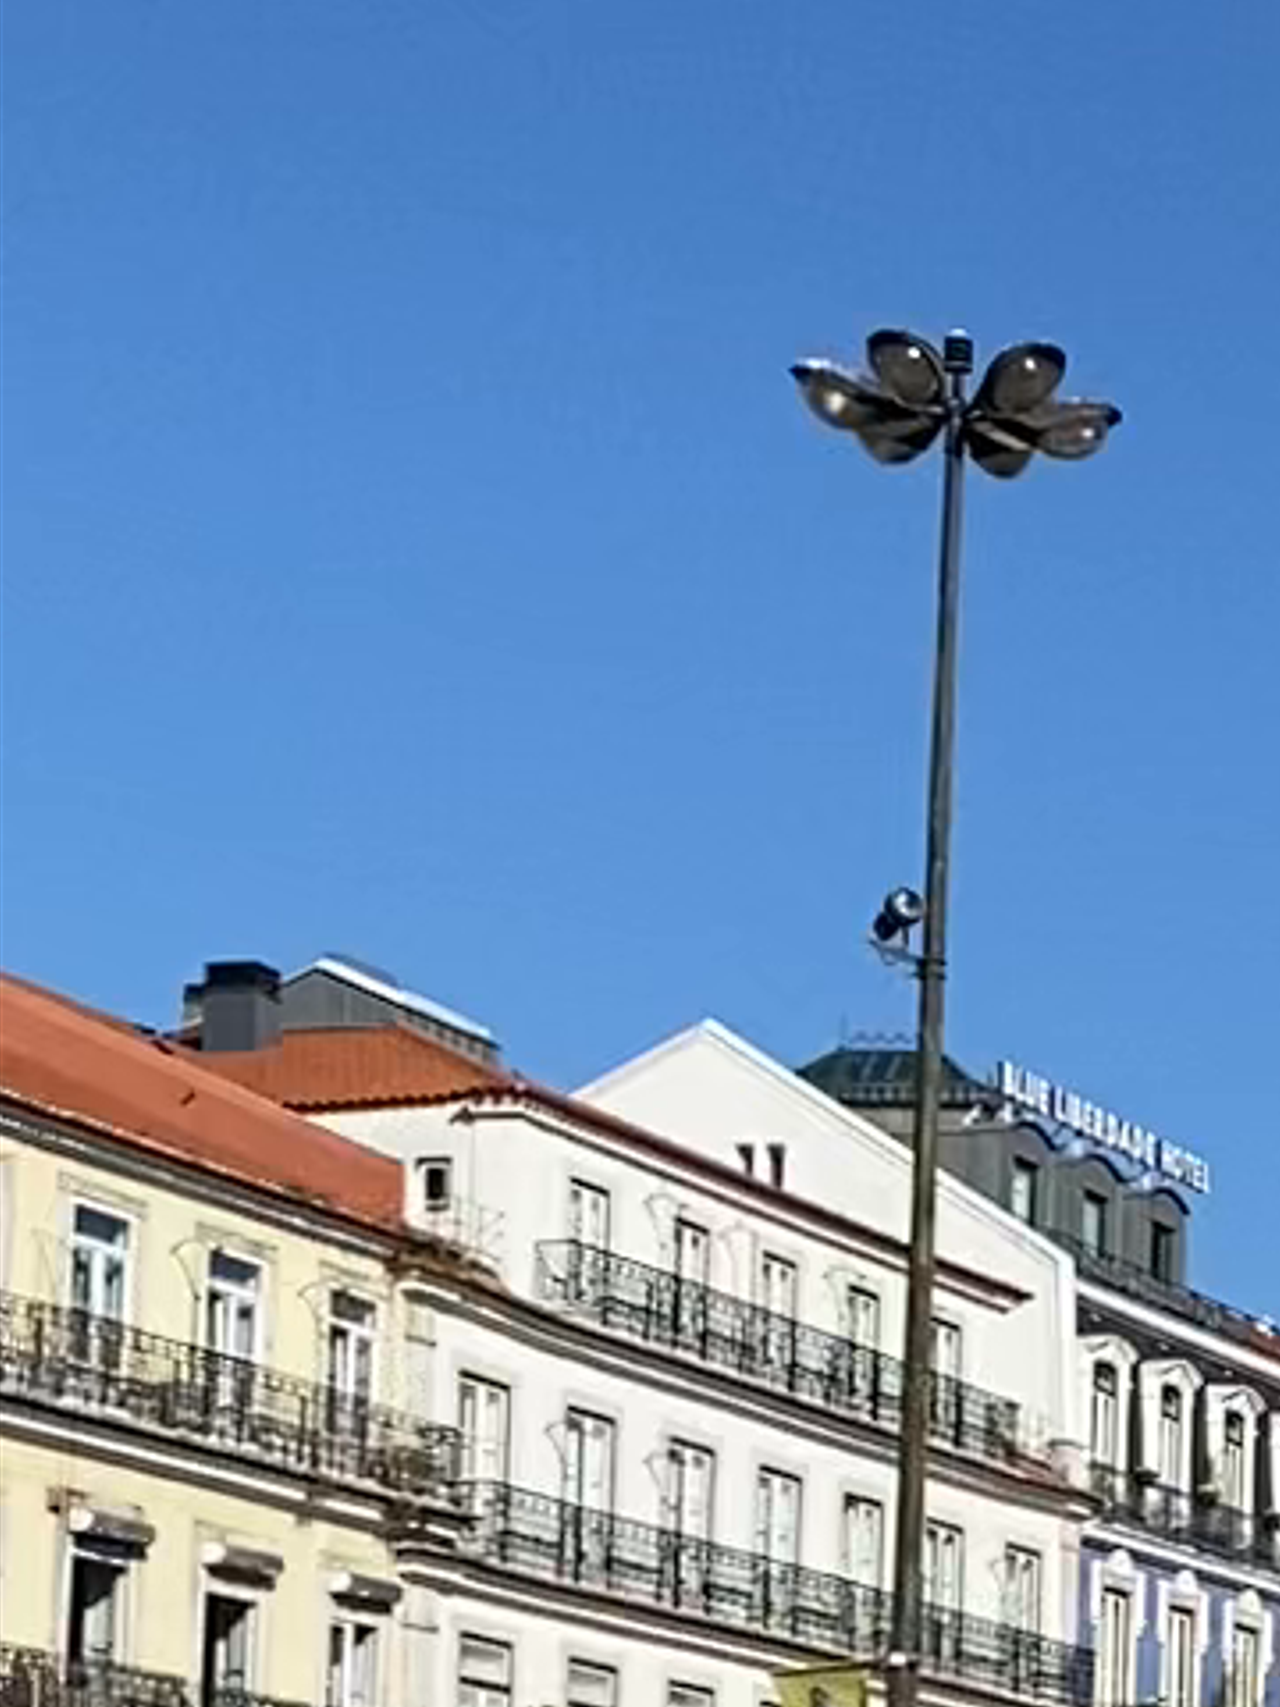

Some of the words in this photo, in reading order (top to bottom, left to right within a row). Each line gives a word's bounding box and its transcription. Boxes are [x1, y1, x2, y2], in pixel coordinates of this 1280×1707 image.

[1000, 1059, 1050, 1115] BLUE
[1053, 1086, 1156, 1171] LIBERDADE
[1160, 1140, 1210, 1193] HOTEL
